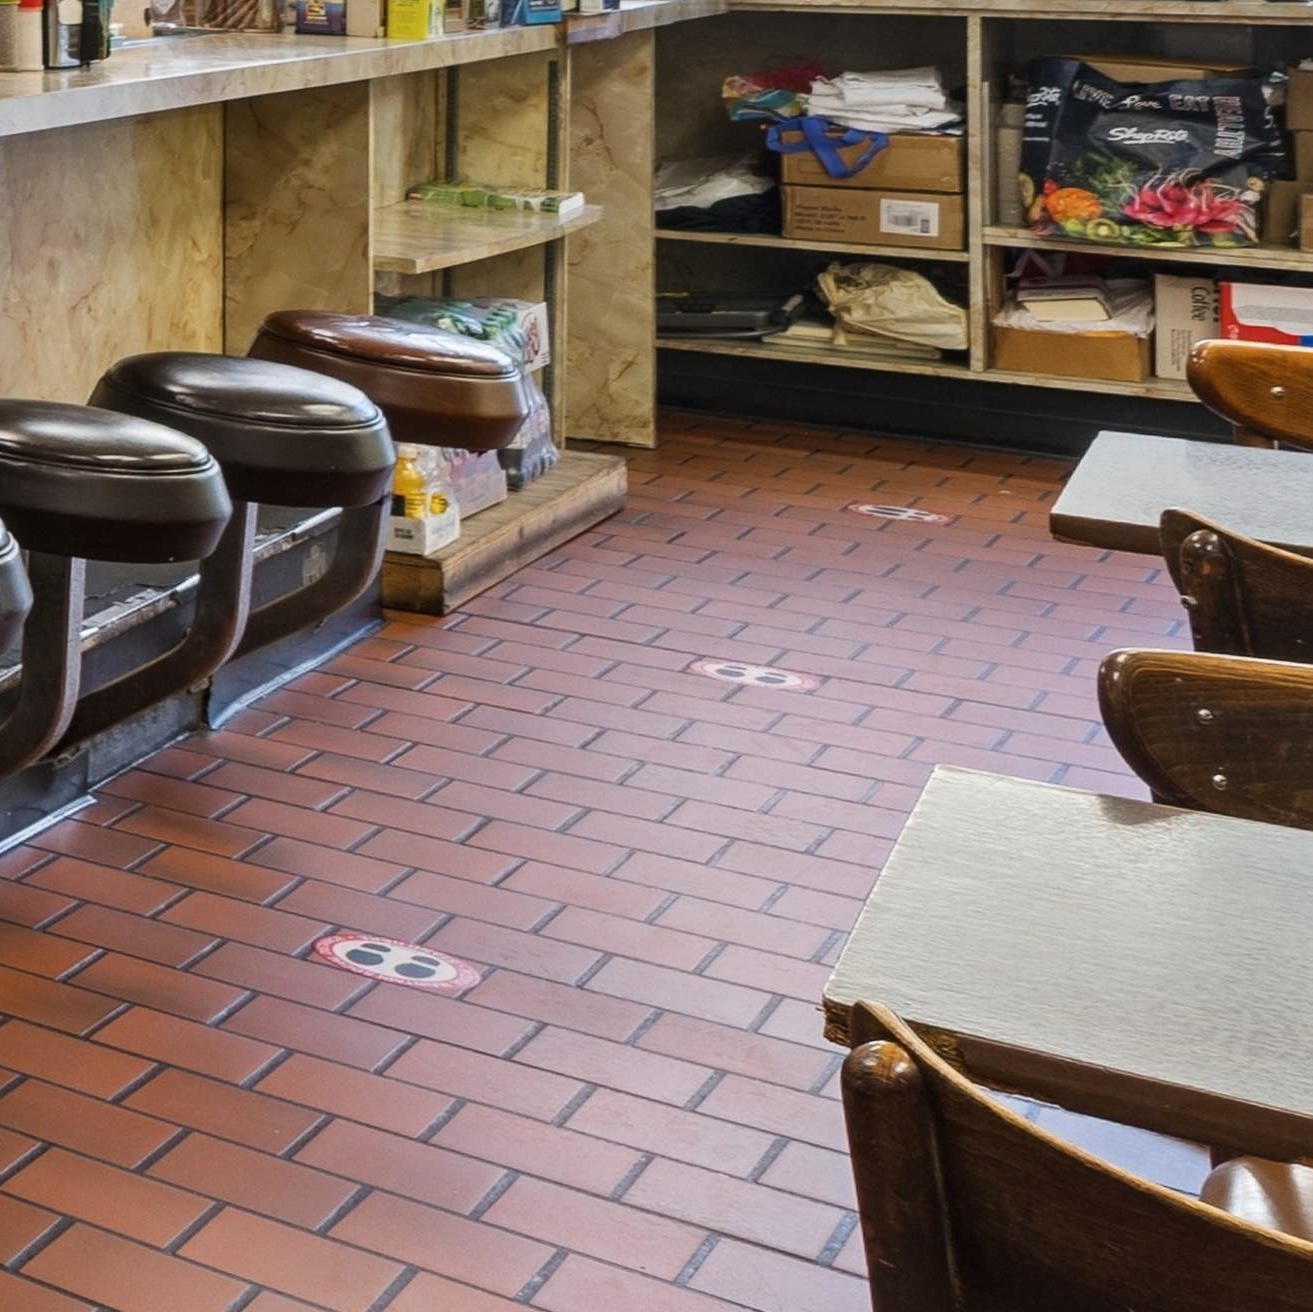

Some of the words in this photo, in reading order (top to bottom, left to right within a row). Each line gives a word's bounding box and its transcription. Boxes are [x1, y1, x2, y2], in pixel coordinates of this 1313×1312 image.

[1168, 94, 1210, 112] EAT
[1108, 127, 1189, 144] ShopRite
[1191, 286, 1210, 322] Coffee
